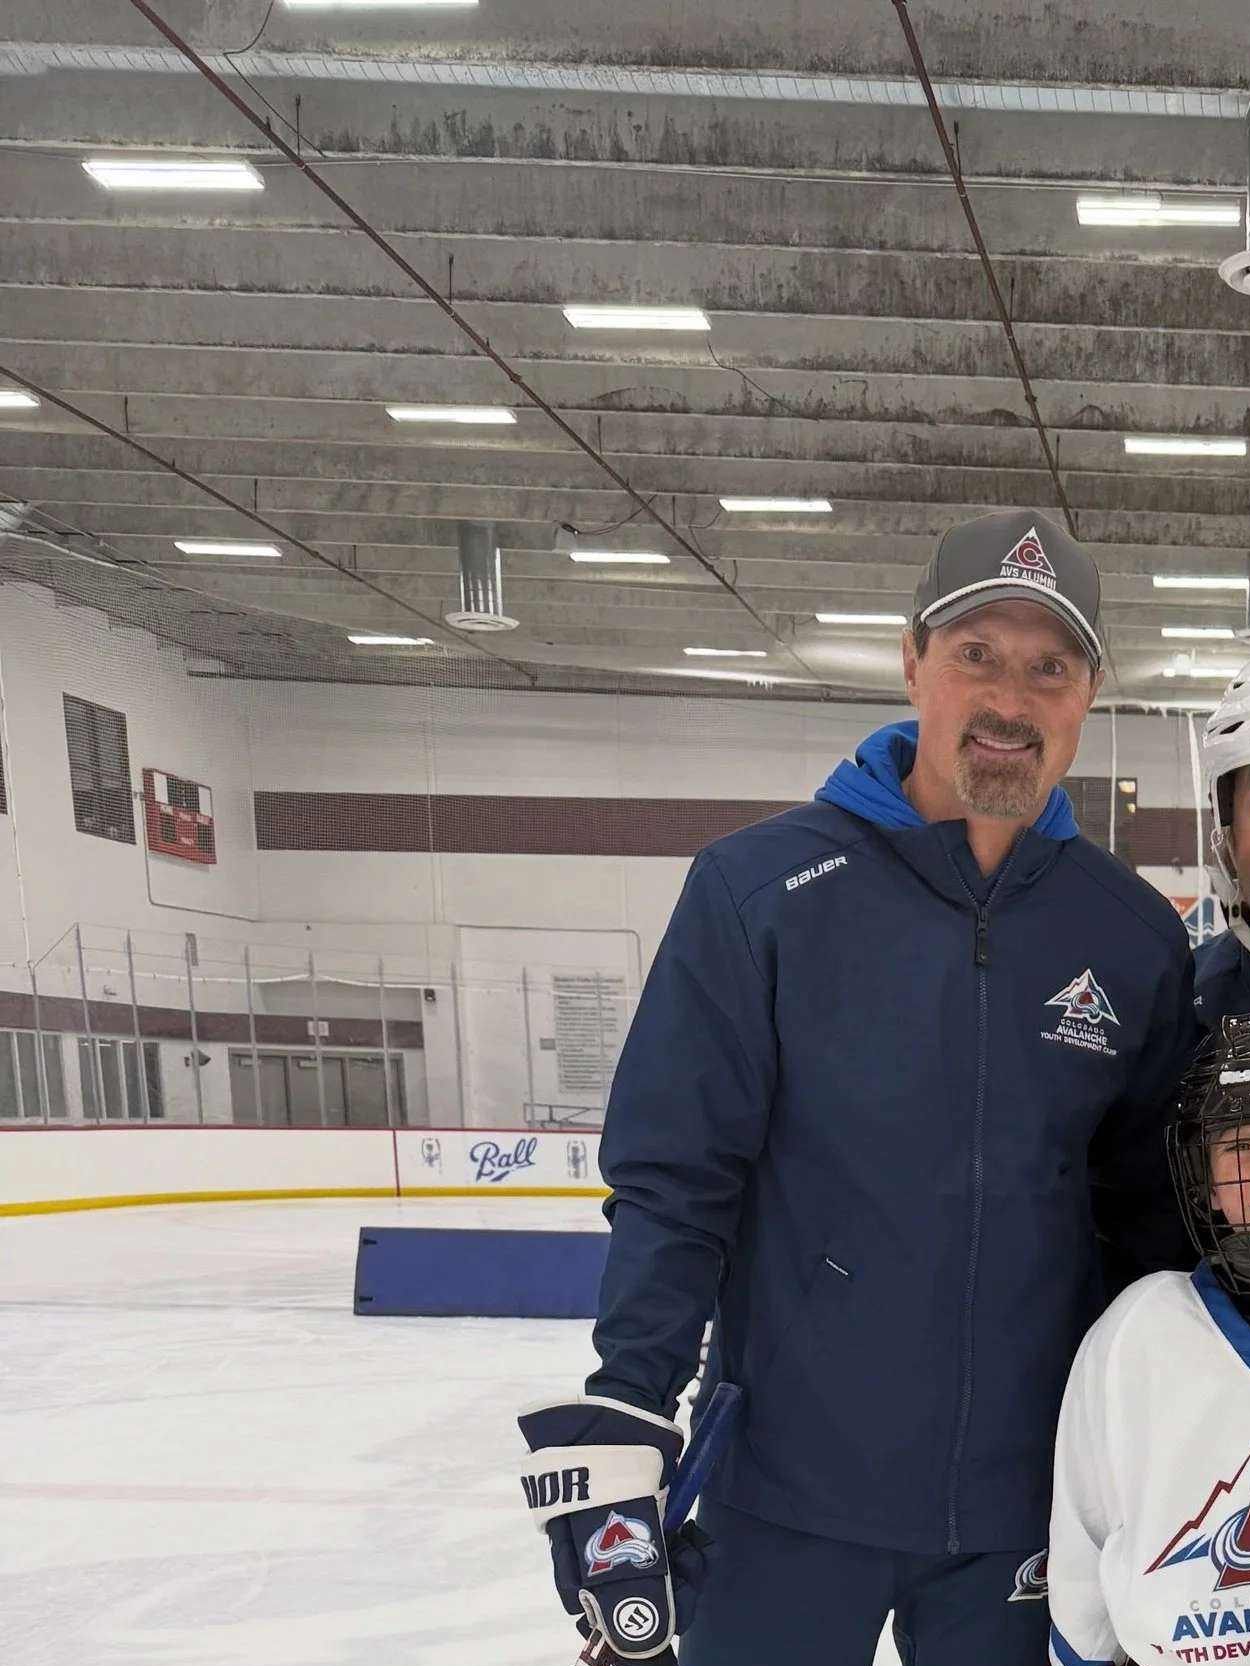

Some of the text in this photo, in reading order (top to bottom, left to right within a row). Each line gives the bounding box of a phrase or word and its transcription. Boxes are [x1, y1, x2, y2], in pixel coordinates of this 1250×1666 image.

[1000, 565, 1056, 590] AVS ALUMNI
[1040, 1031, 1062, 1042] YOUTH
[1056, 1025, 1108, 1046] AVALANCHE
[470, 1137, 538, 1183] Ball
